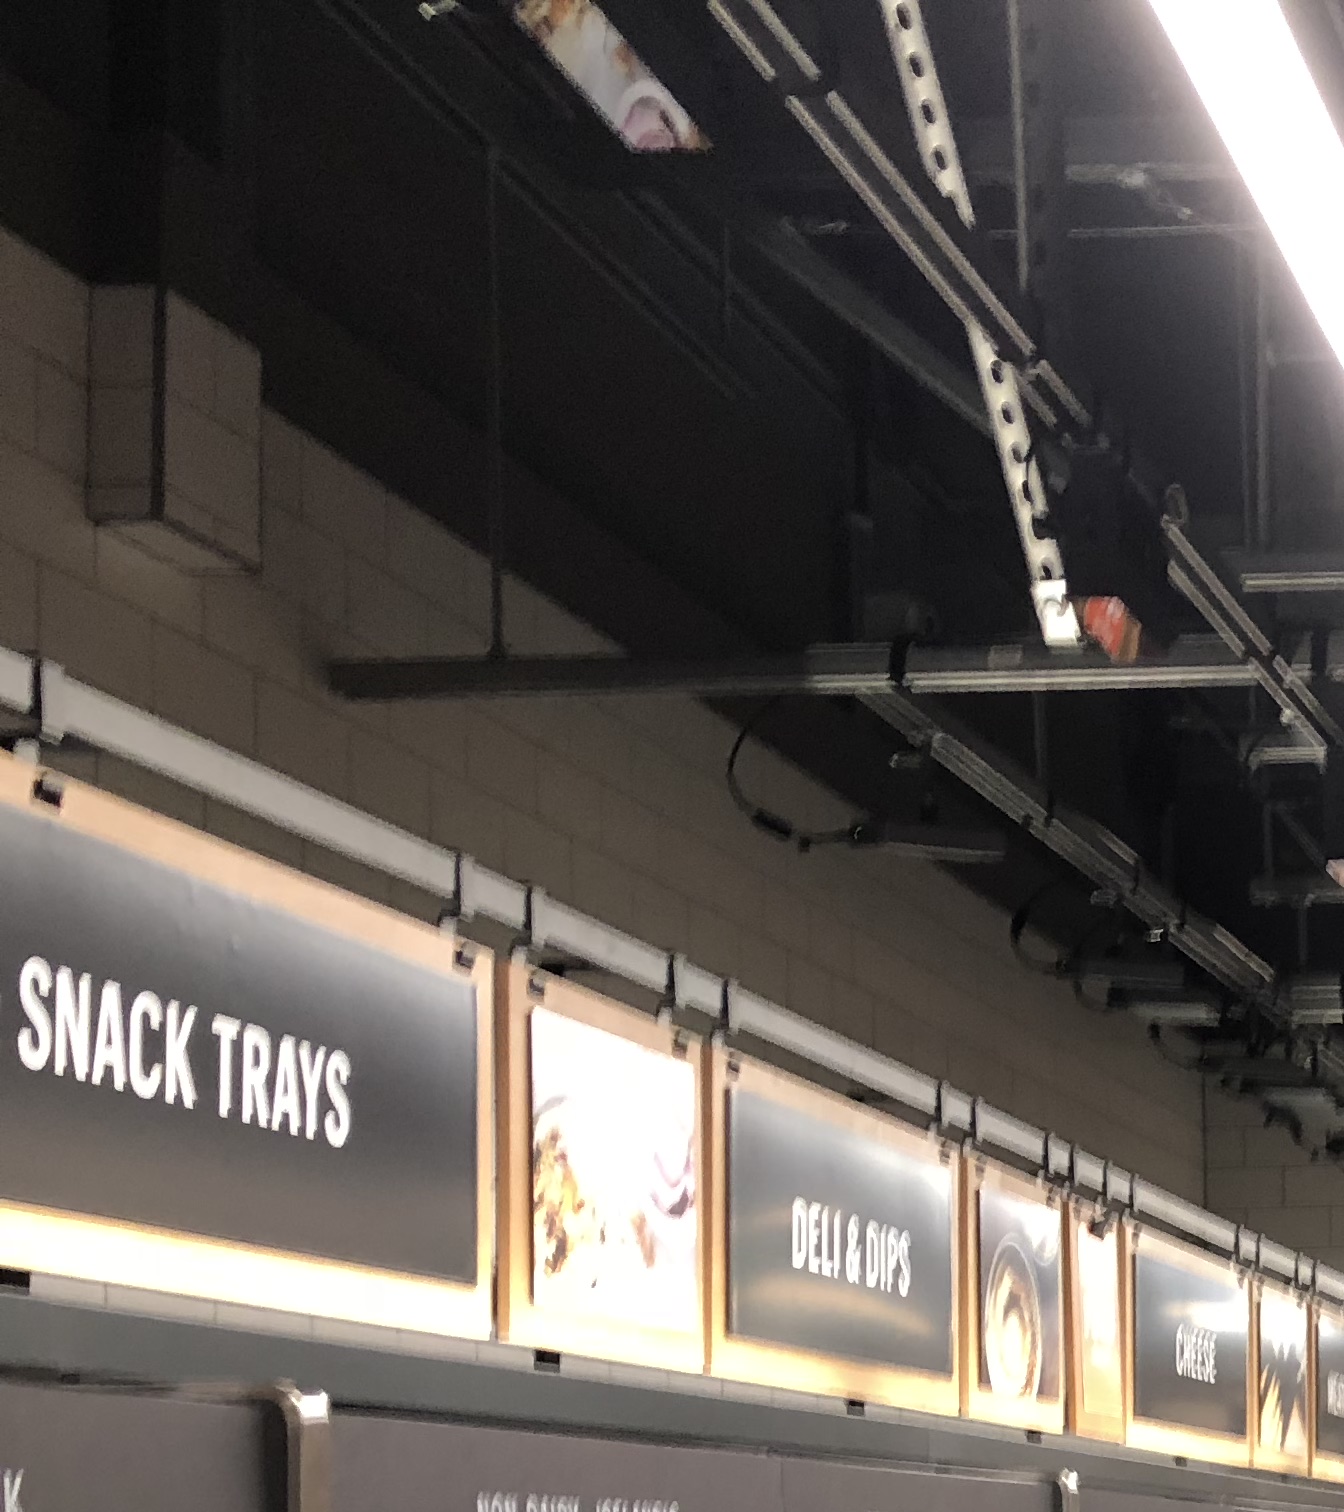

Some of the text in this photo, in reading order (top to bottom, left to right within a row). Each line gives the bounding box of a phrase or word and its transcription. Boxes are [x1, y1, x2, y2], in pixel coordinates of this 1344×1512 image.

[18, 956, 352, 1148] SNACK TRAYS
[792, 1196, 911, 1298] DELI & DIPS
[1176, 1323, 1218, 1385] CHEESE
